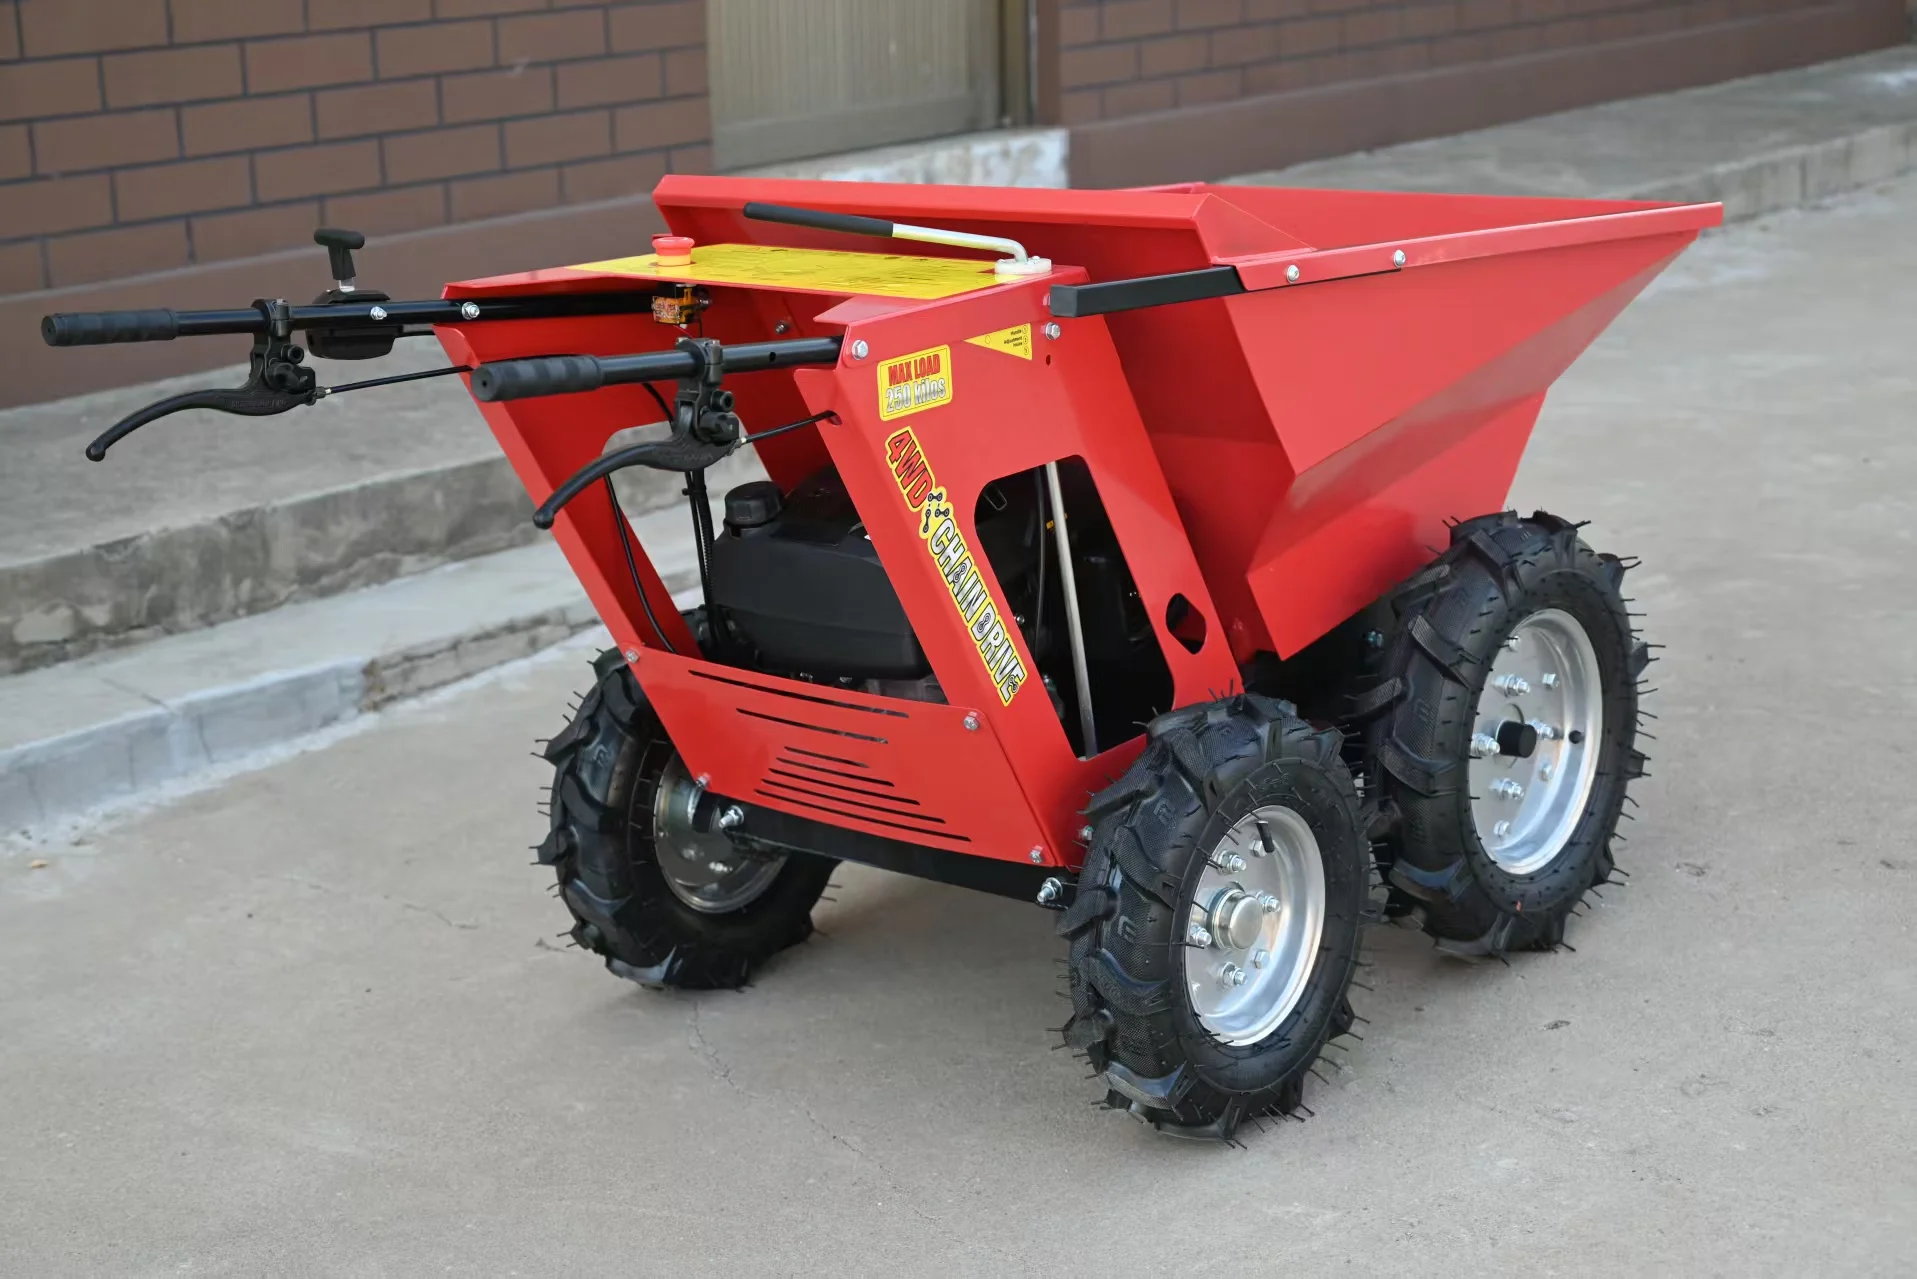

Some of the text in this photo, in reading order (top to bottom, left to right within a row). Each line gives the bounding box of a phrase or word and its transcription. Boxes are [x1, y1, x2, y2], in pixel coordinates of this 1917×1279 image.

[888, 354, 941, 387] MAX LOAD
[886, 378, 946, 413] 250 kilos
[888, 430, 1026, 704] 4WD CHAIN DRIVE
